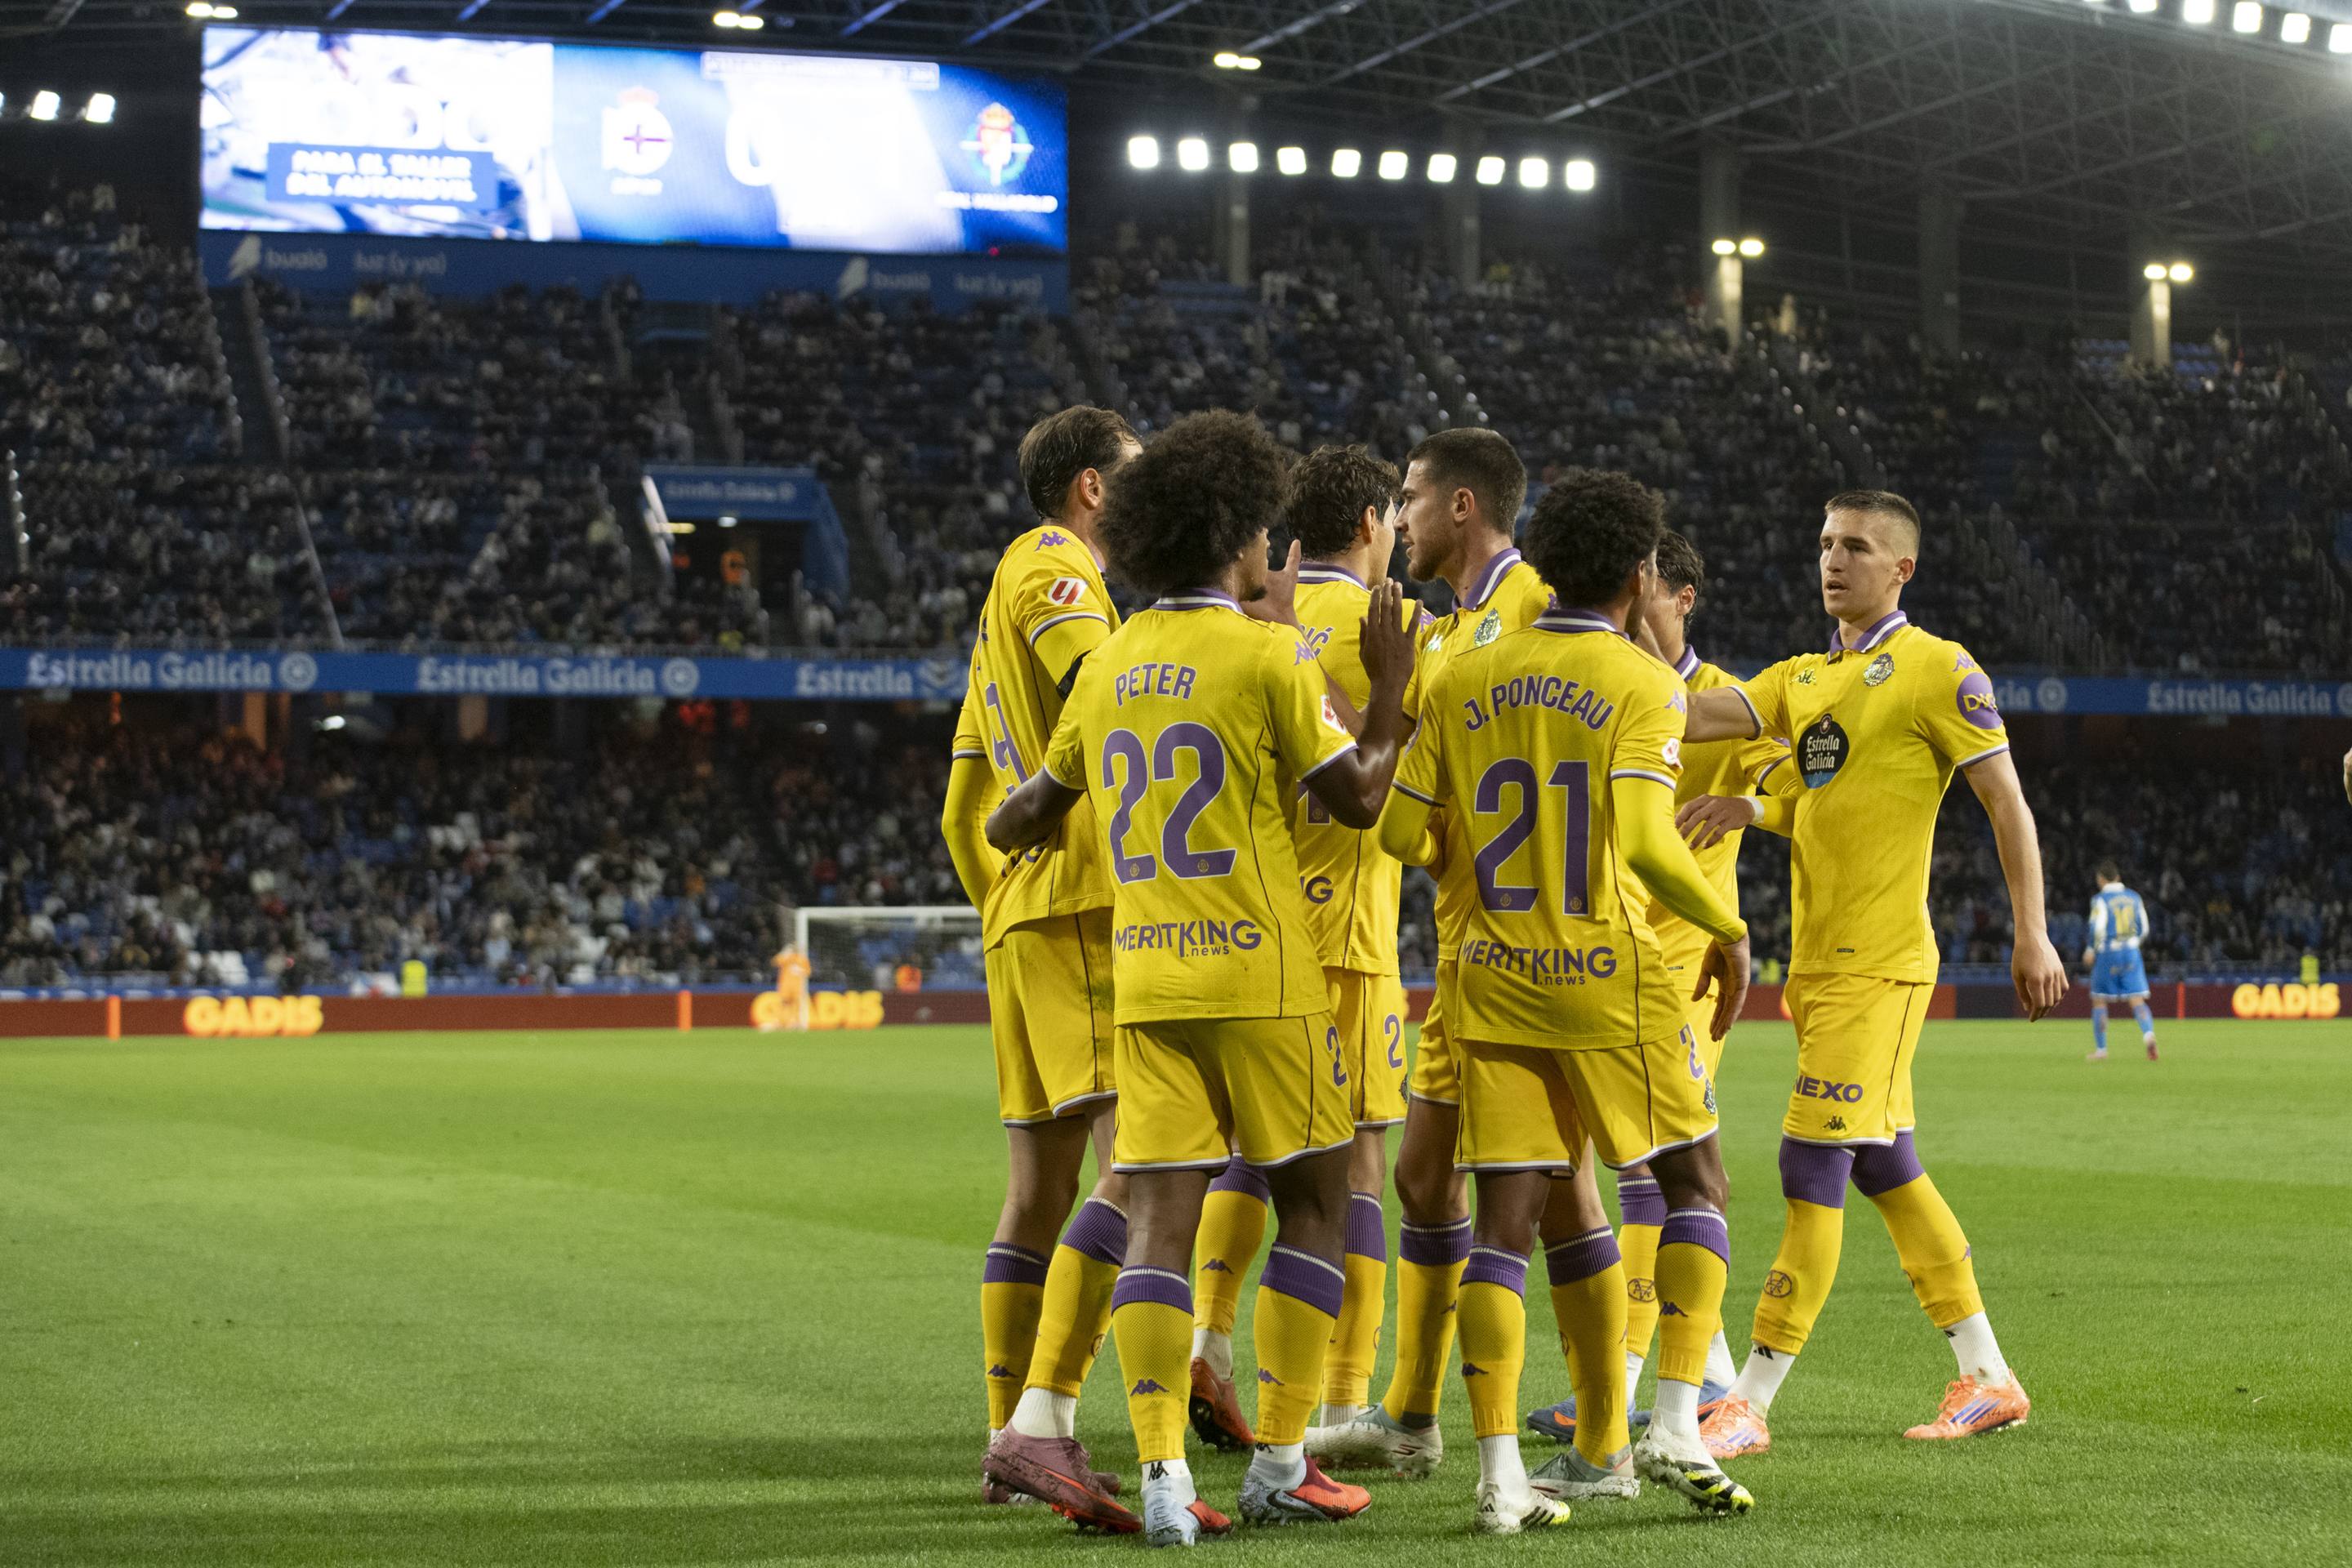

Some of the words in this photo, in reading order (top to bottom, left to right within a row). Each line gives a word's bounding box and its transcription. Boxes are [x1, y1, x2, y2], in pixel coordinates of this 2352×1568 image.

[27, 652, 152, 687] Estrella
[158, 651, 273, 687] Galicia
[417, 657, 539, 692] Estrella
[543, 657, 656, 693] Galicia
[795, 662, 913, 696] Estrella
[1114, 662, 1197, 707] PETER
[2146, 681, 2241, 712] Estrella
[2246, 682, 2331, 715] Galicia
[1806, 735, 1840, 753] Estrella
[1806, 752, 1836, 771] Galicia
[1102, 722, 1237, 885] 22
[1474, 757, 1591, 917] 21
[1114, 920, 1262, 957] MERITKING
[185, 996, 324, 1037] GADIS
[751, 990, 885, 1030] GDIS
[2232, 982, 2341, 1020] GADIS
